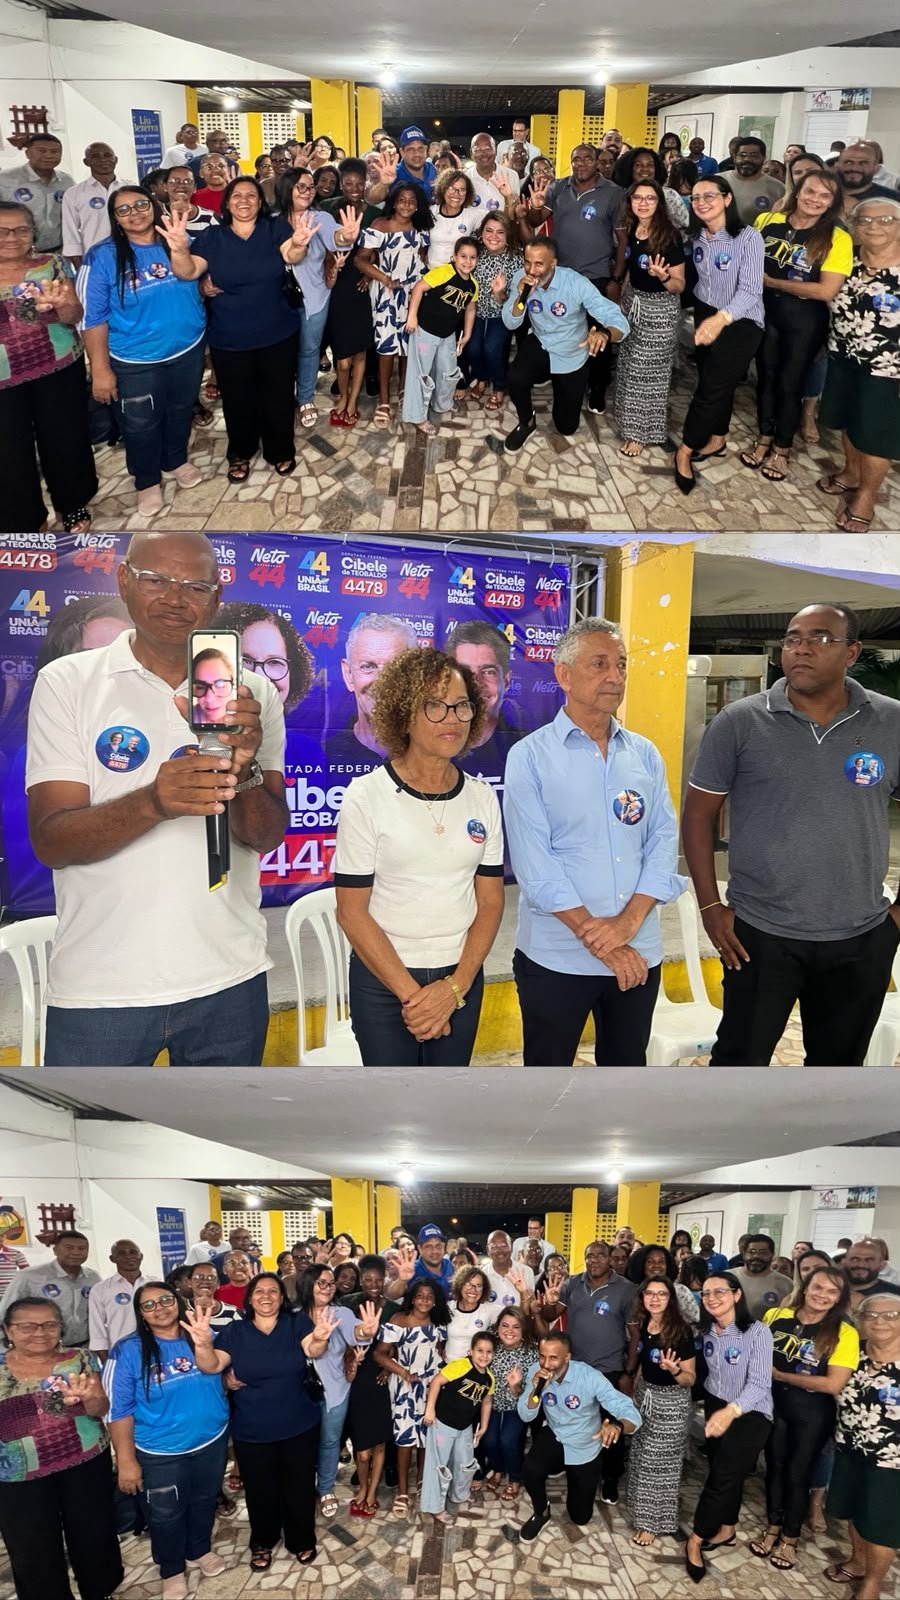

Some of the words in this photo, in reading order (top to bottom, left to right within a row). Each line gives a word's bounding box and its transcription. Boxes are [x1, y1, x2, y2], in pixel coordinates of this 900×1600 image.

[7, 541, 57, 551] TEOBALDO
[74, 533, 121, 549] Neto
[214, 545, 237, 559] ele
[250, 548, 291, 565] Neto
[0, 552, 53, 570] 4478
[73, 548, 117, 576] 44
[298, 550, 332, 577] 44
[341, 556, 389, 573] Cibele
[249, 562, 287, 590] 44
[351, 569, 389, 580] TEOBALDO
[399, 562, 435, 579] Neto
[448, 565, 477, 590] 44
[344, 579, 385, 596] 4478
[485, 572, 526, 587] Cibele
[536, 577, 566, 591] Neto
[297, 583, 331, 594] BRASIL
[397, 576, 431, 601] 44
[493, 584, 526, 593] TEOBALDO
[10, 589, 51, 618] 44
[447, 595, 476, 606] BRASIL
[487, 592, 523, 608] 4478
[534, 590, 561, 611] 44
[305, 610, 344, 627] Neto
[302, 623, 340, 649] 44
[531, 680, 561, 694] Neto
[285, 764, 323, 774] TADA
[329, 763, 380, 774] FEDERA
[284, 777, 347, 811] ibe
[259, 839, 338, 878] 447
